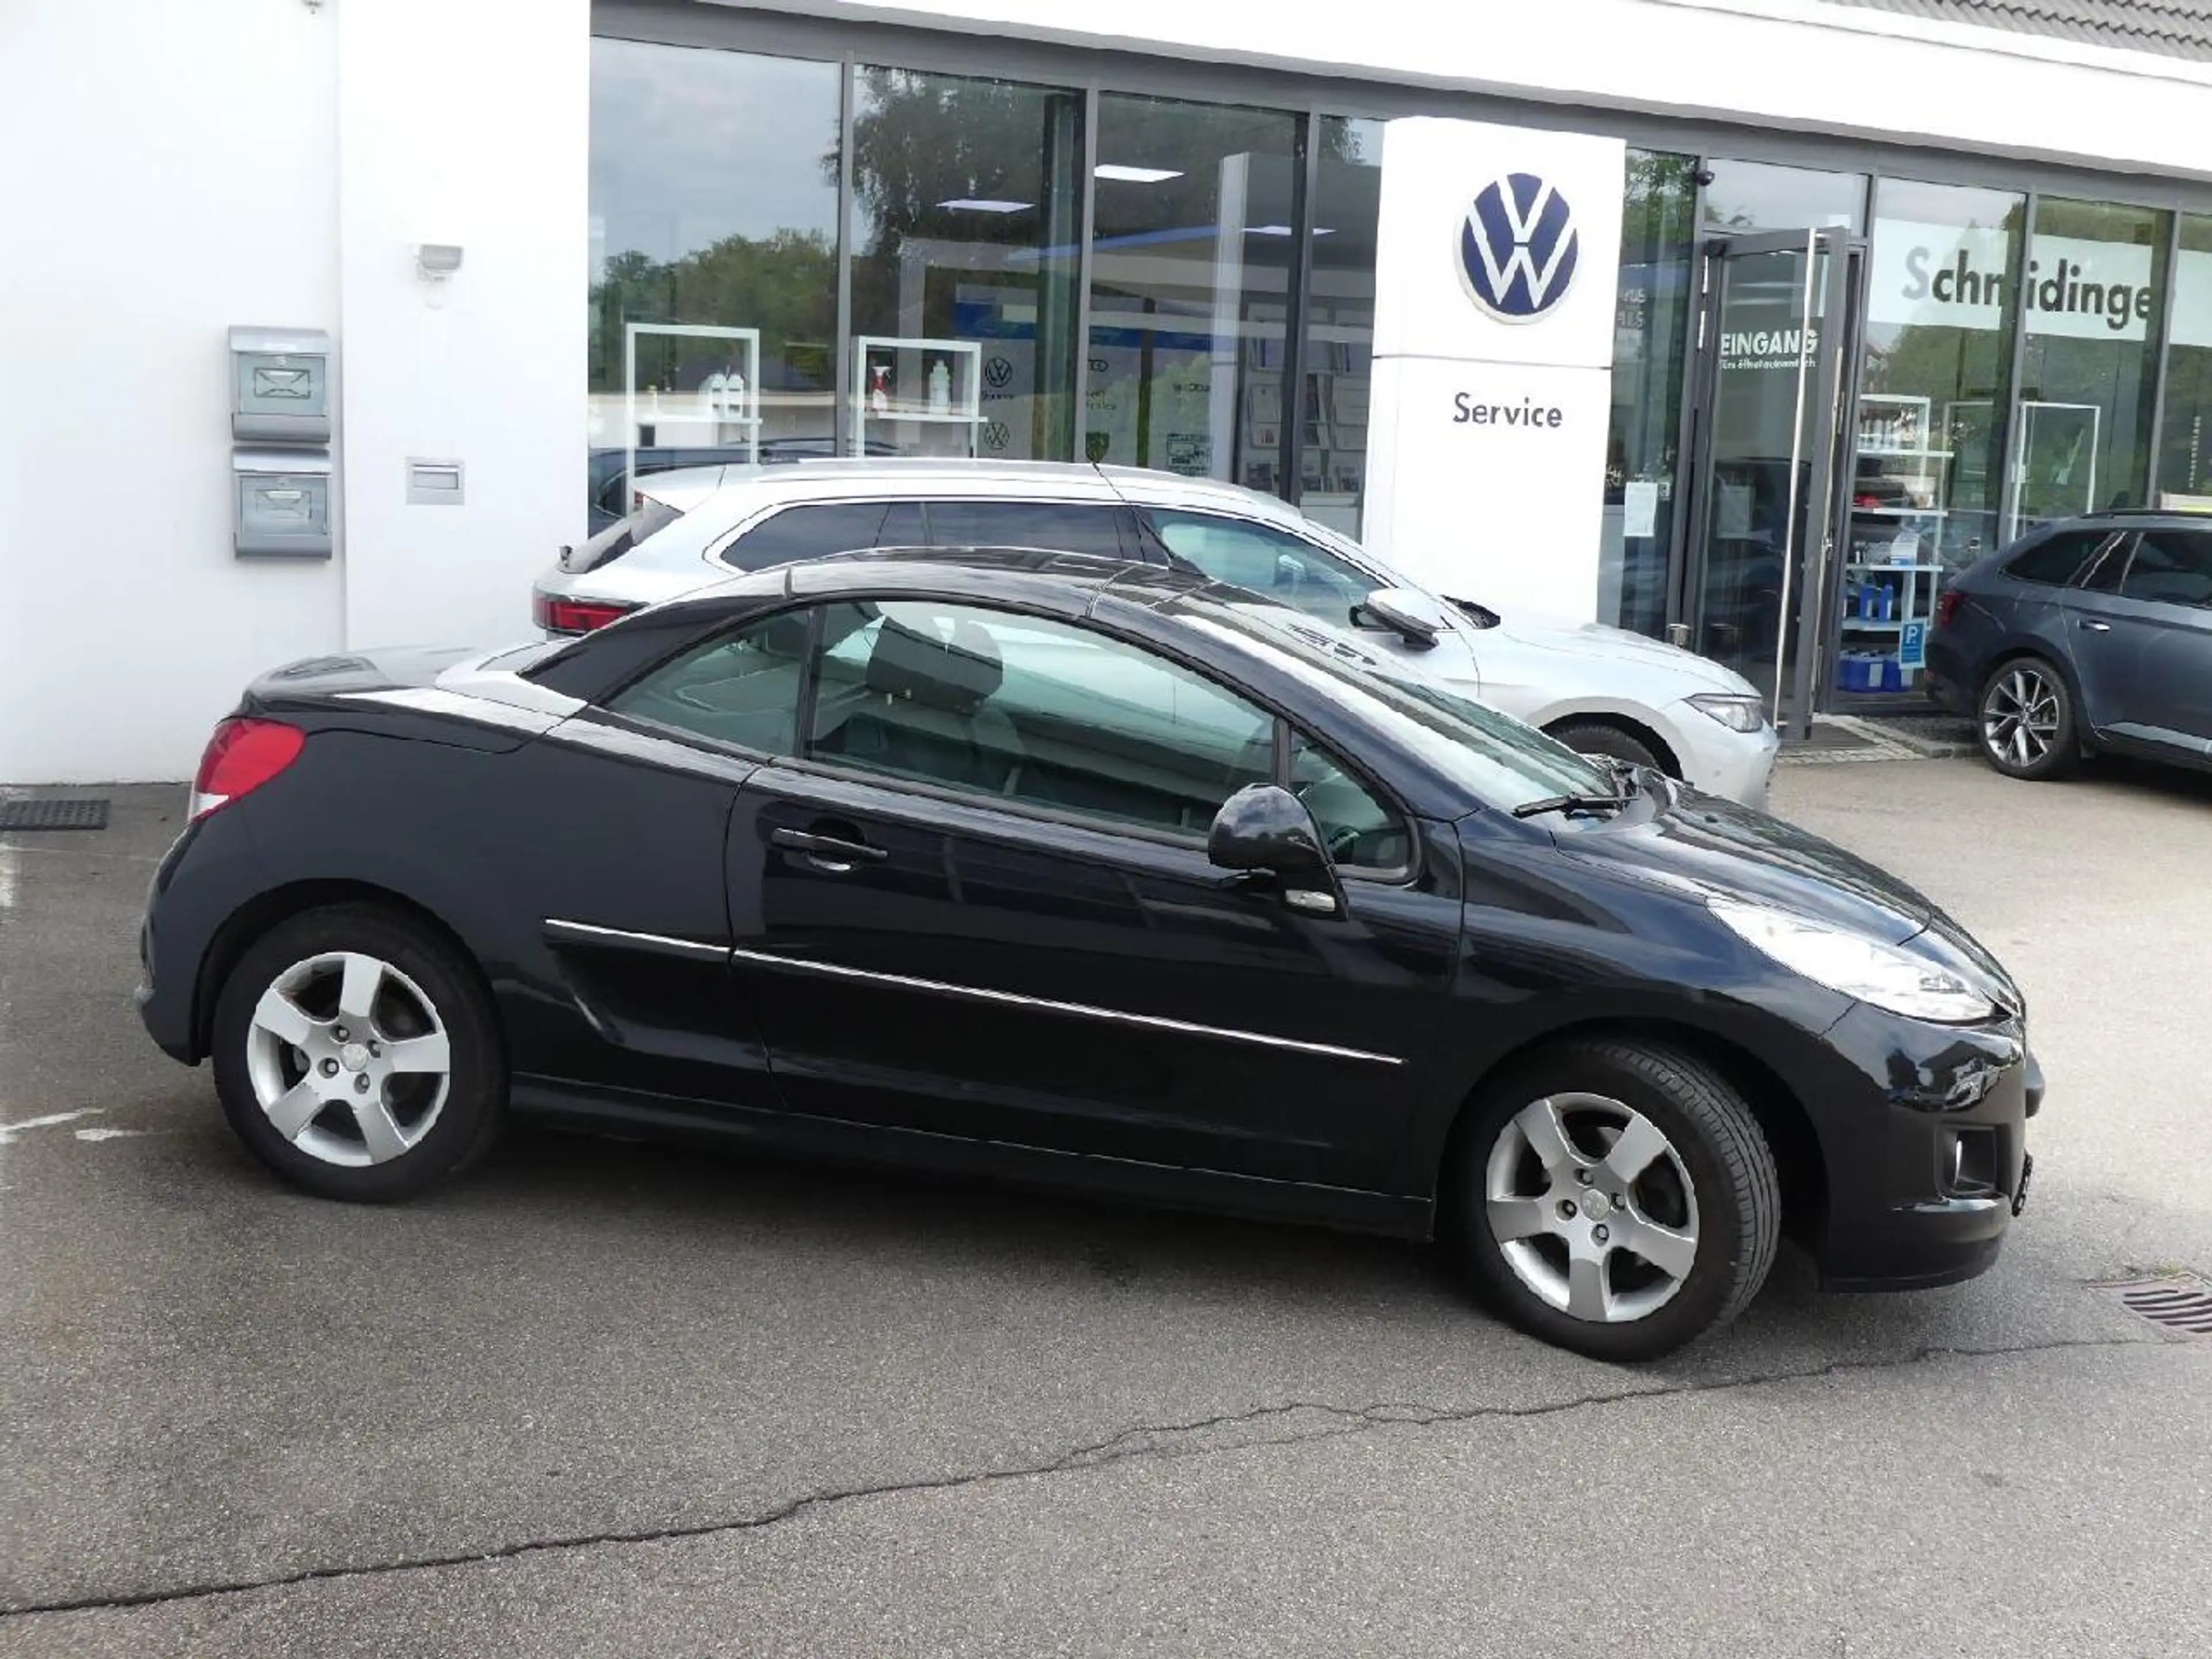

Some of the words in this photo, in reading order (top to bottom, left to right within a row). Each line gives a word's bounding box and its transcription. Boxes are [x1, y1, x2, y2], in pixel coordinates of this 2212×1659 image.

[1902, 247, 2151, 330] Schnidinge
[1721, 329, 1819, 355] EINGANG
[1453, 392, 1562, 427] Service
[1906, 625, 1917, 643] P
